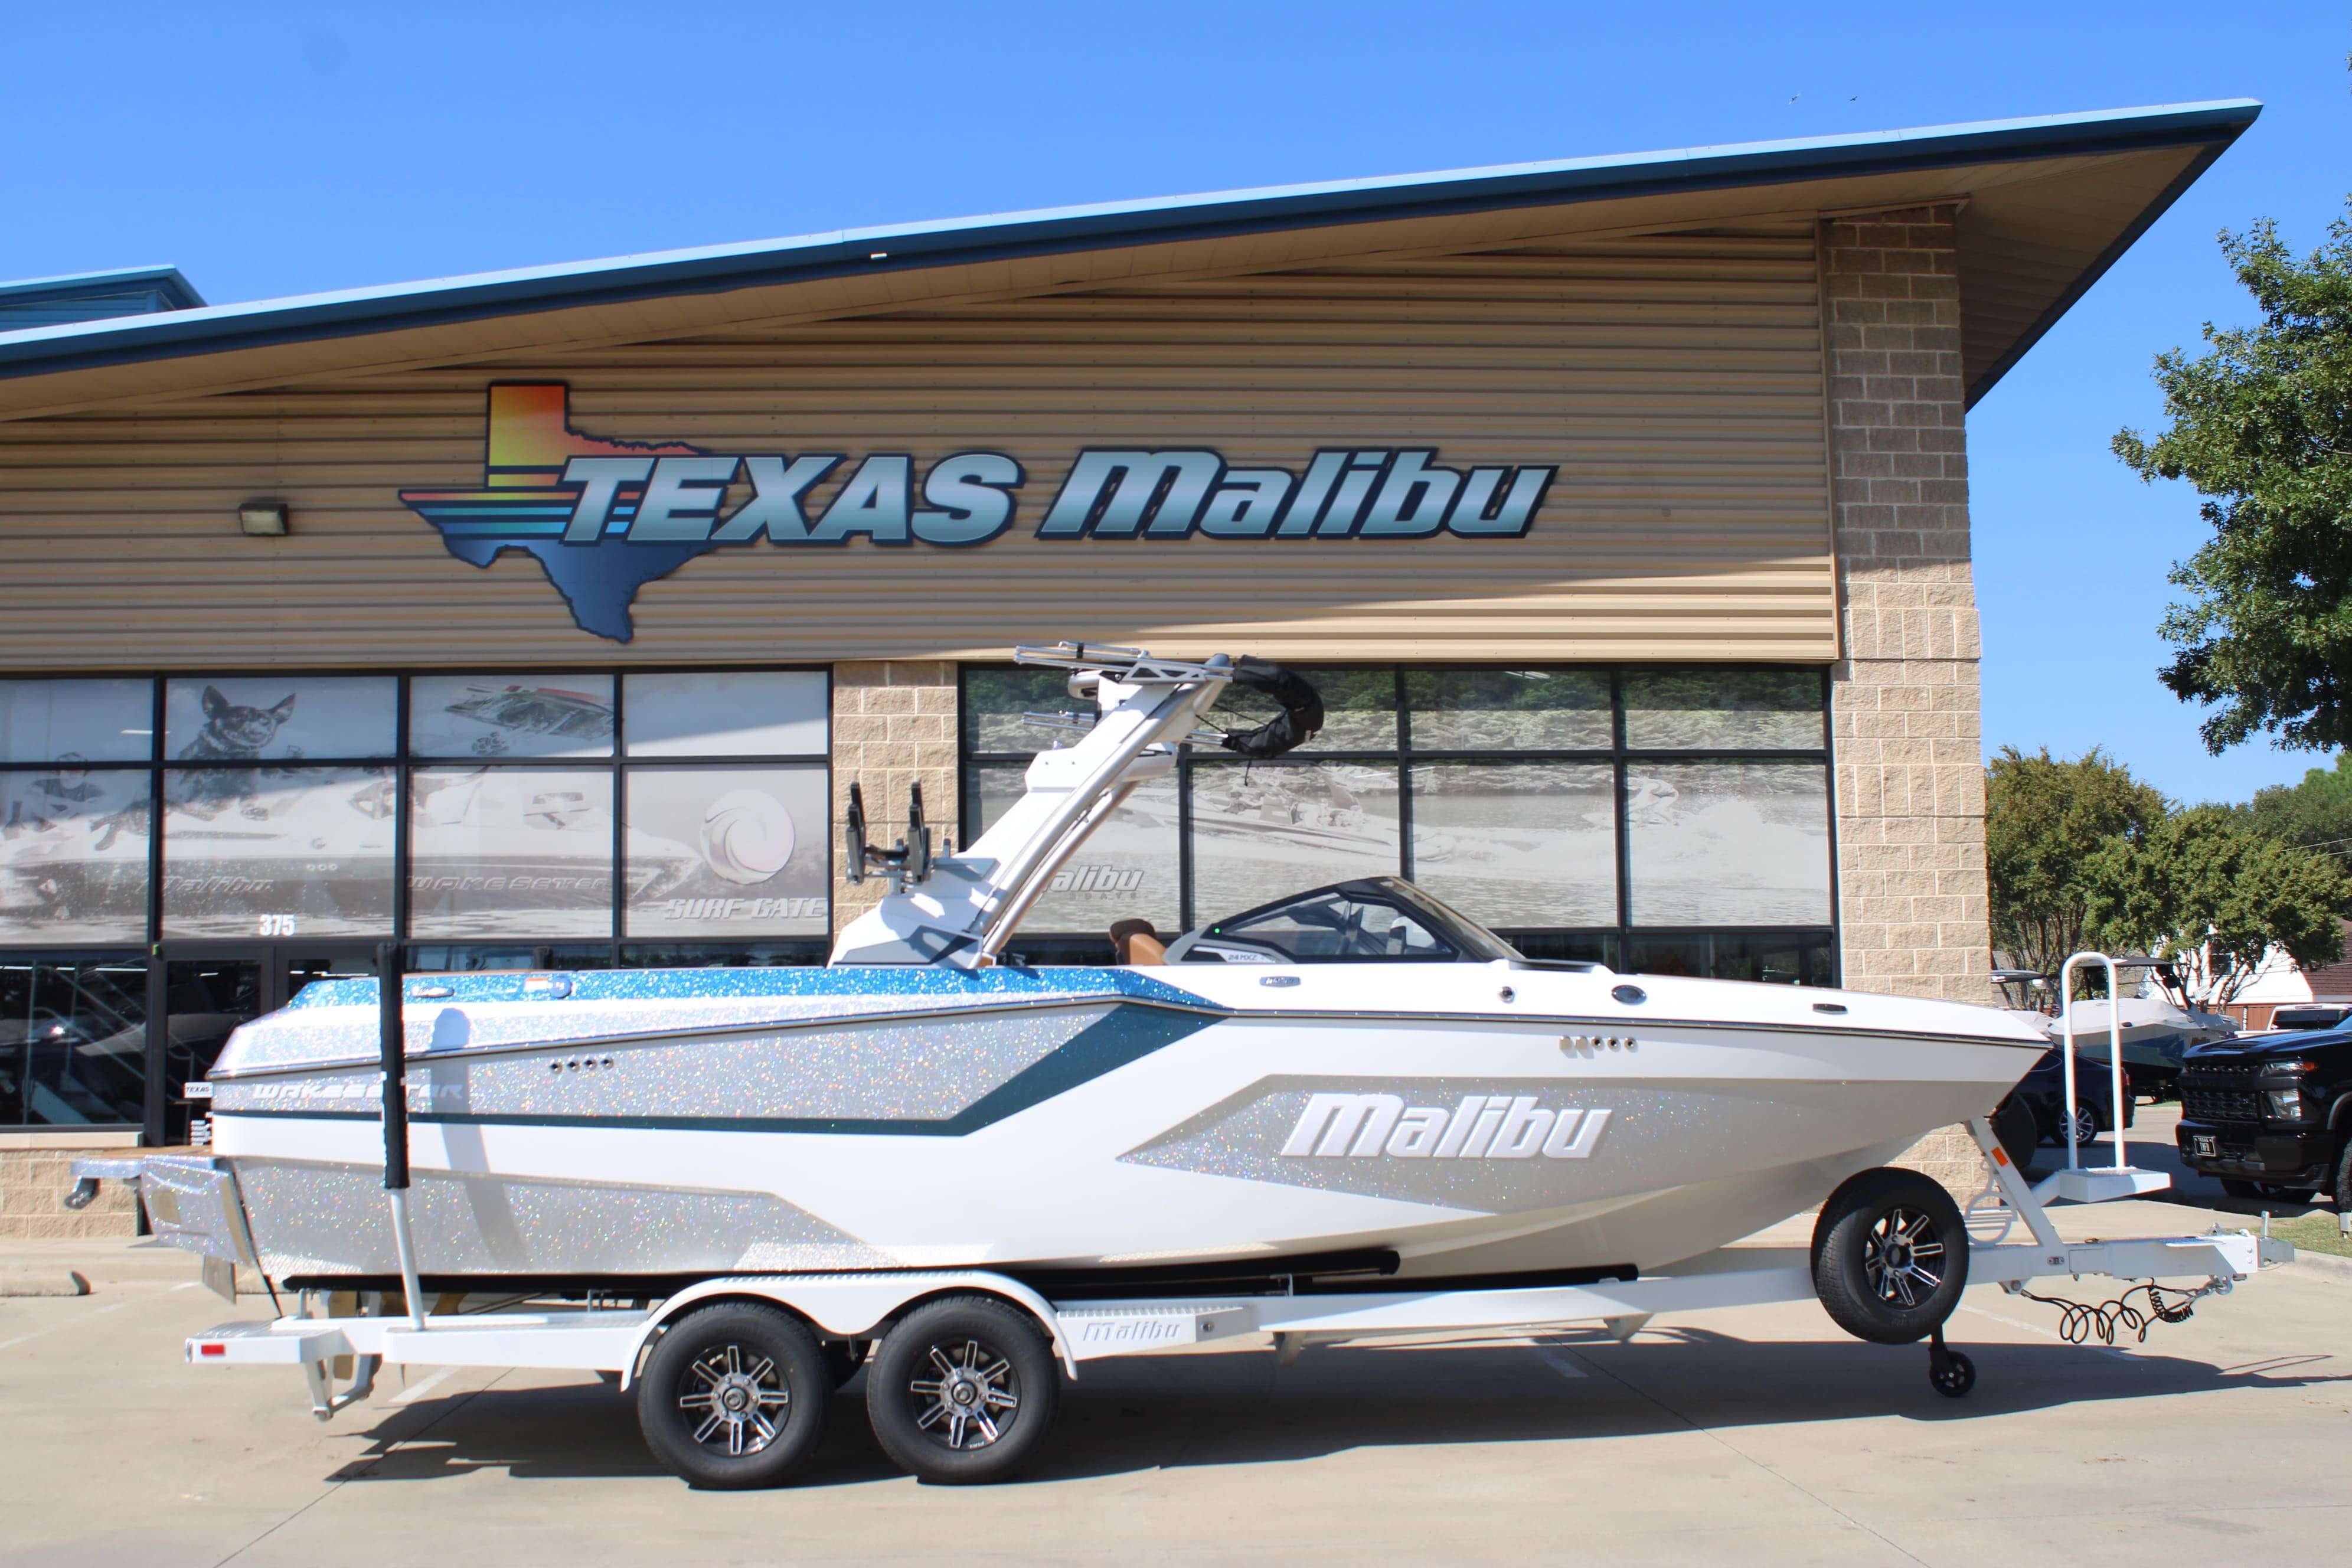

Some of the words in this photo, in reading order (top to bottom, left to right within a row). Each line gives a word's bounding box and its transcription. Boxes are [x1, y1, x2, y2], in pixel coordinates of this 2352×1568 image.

[560, 452, 1026, 548] TEXAS
[1034, 447, 1559, 540] Malibu
[1044, 864, 1144, 892] alibu
[665, 898, 744, 920] SURF
[751, 897, 828, 919] GATE
[259, 914, 295, 936] 375
[1280, 1093, 1612, 1158] Malibu
[1083, 1321, 1180, 1341] Malibu
